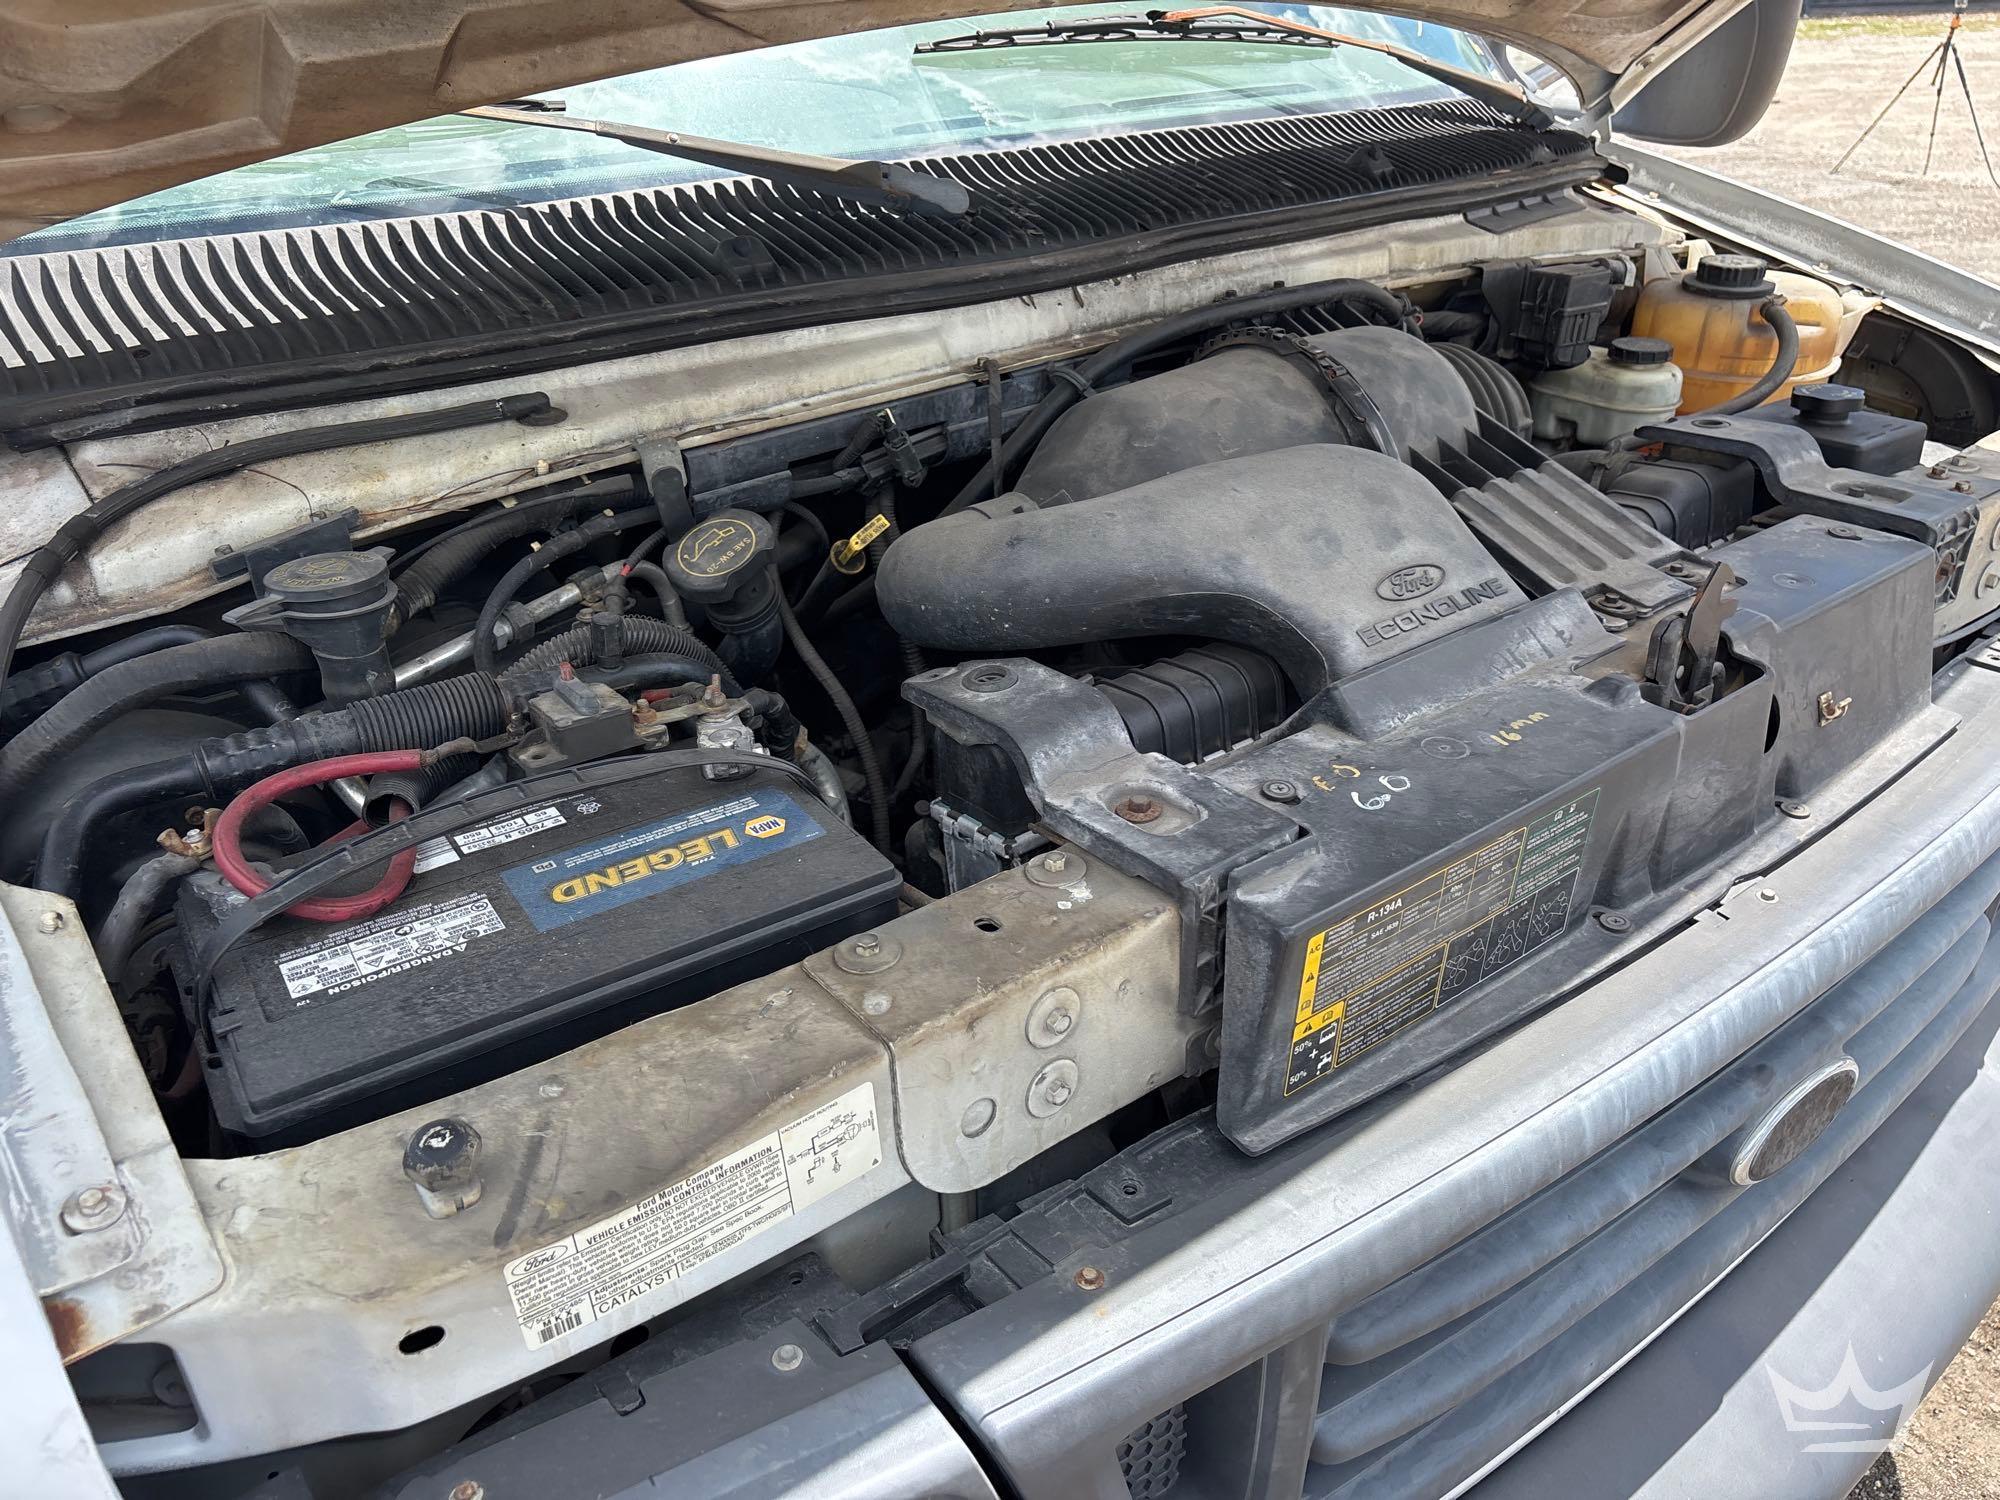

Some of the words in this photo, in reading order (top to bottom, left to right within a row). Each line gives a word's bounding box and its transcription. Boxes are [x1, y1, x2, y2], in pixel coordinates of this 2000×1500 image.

[734, 537, 751, 553] SAE
[706, 550, 735, 573] 5W-20
[1389, 568, 1435, 598] Ford
[1356, 578, 1508, 647] ECONOLINE
[462, 831, 481, 839] 850
[494, 820, 518, 830] 1045
[517, 823, 546, 835] 7565
[747, 818, 781, 834] NAPA
[535, 861, 553, 872] Pb
[552, 827, 740, 904] LEGEND
[1367, 896, 1403, 923] R-134A
[1370, 927, 1384, 939] SAE
[327, 948, 452, 994] DANGER/POISON
[296, 998, 310, 1006] 12V
[1293, 1037, 1312, 1055] 50%
[1288, 1067, 1307, 1085] 50%
[781, 1121, 801, 1134] VACUUM
[586, 1221, 625, 1246] VEHICLE
[627, 1198, 670, 1226] EMISSION
[673, 1177, 712, 1202] CONTROL
[715, 1146, 772, 1180] INFORMATION
[636, 1195, 656, 1211] Ford
[658, 1182, 683, 1201] Motor
[685, 1161, 723, 1188] Company
[512, 1274, 536, 1292] Weight
[537, 1265, 554, 1279] limits
[556, 1257, 571, 1270] refer
[572, 1253, 579, 1262] to
[580, 1239, 609, 1258] Emission
[610, 1220, 647, 1243] Certification
[663, 1207, 674, 1217] DO
[674, 1199, 688, 1211] NOT
[689, 1185, 717, 1203] EXCEED
[718, 1170, 744, 1188] VEHICLE
[744, 1159, 764, 1174] GVWR
[765, 1152, 778, 1165] (See
[513, 1280, 536, 1296] Owner
[568, 1259, 582, 1270] This
[583, 1247, 606, 1263] vehicle
[608, 1232, 637, 1251] conforms
[638, 1228, 644, 1236] to
[661, 1213, 675, 1224] EPA
[675, 1196, 708, 1218] regulations
[709, 1180, 738, 1201] applicable
[747, 1167, 761, 1179] 2005
[762, 1158, 779, 1171] model
[542, 1279, 567, 1298] pounds
[576, 1267, 594, 1282] gross
[596, 1255, 618, 1271] vehicle
[619, 1244, 639, 1260] weight
[661, 1227, 673, 1238] and
[689, 1209, 709, 1224] square
[710, 1202, 721, 1212] feet
[729, 1188, 747, 1201] frontal
[764, 1172, 775, 1183] and
[516, 1291, 532, 1304] year
[533, 1283, 548, 1294] new
[550, 1263, 587, 1288] heavy-duty
[589, 1250, 615, 1268] vehicles
[617, 1240, 635, 1253] when
[643, 1228, 658, 1241] does
[660, 1222, 671, 1232] not
[672, 1209, 695, 1226] exceed
[714, 1187, 736, 1204] pounds
[745, 1175, 758, 1186] curb
[593, 1264, 647, 1298] Adjustments:
[649, 1252, 671, 1269] Spark
[673, 1242, 690, 1257] Plug
[710, 1224, 724, 1235] See
[725, 1213, 743, 1228] Spec
[744, 1203, 763, 1217] Book.
[519, 1294, 551, 1315] California
[552, 1276, 588, 1300] regulations
[589, 1260, 621, 1282] applicable
[622, 1256, 629, 1264] to
[630, 1250, 642, 1260] new
[644, 1242, 657, 1253] LEV
[658, 1222, 696, 1247] medium-duty
[723, 1199, 737, 1211] OBD
[523, 1250, 557, 1272] Ford
[594, 1291, 606, 1302] No
[608, 1280, 628, 1295] other
[630, 1256, 675, 1286] adjustments
[598, 1267, 673, 1315] CATALYST
[542, 1318, 551, 1328] M
[554, 1313, 561, 1322] K
[565, 1308, 572, 1316] X
